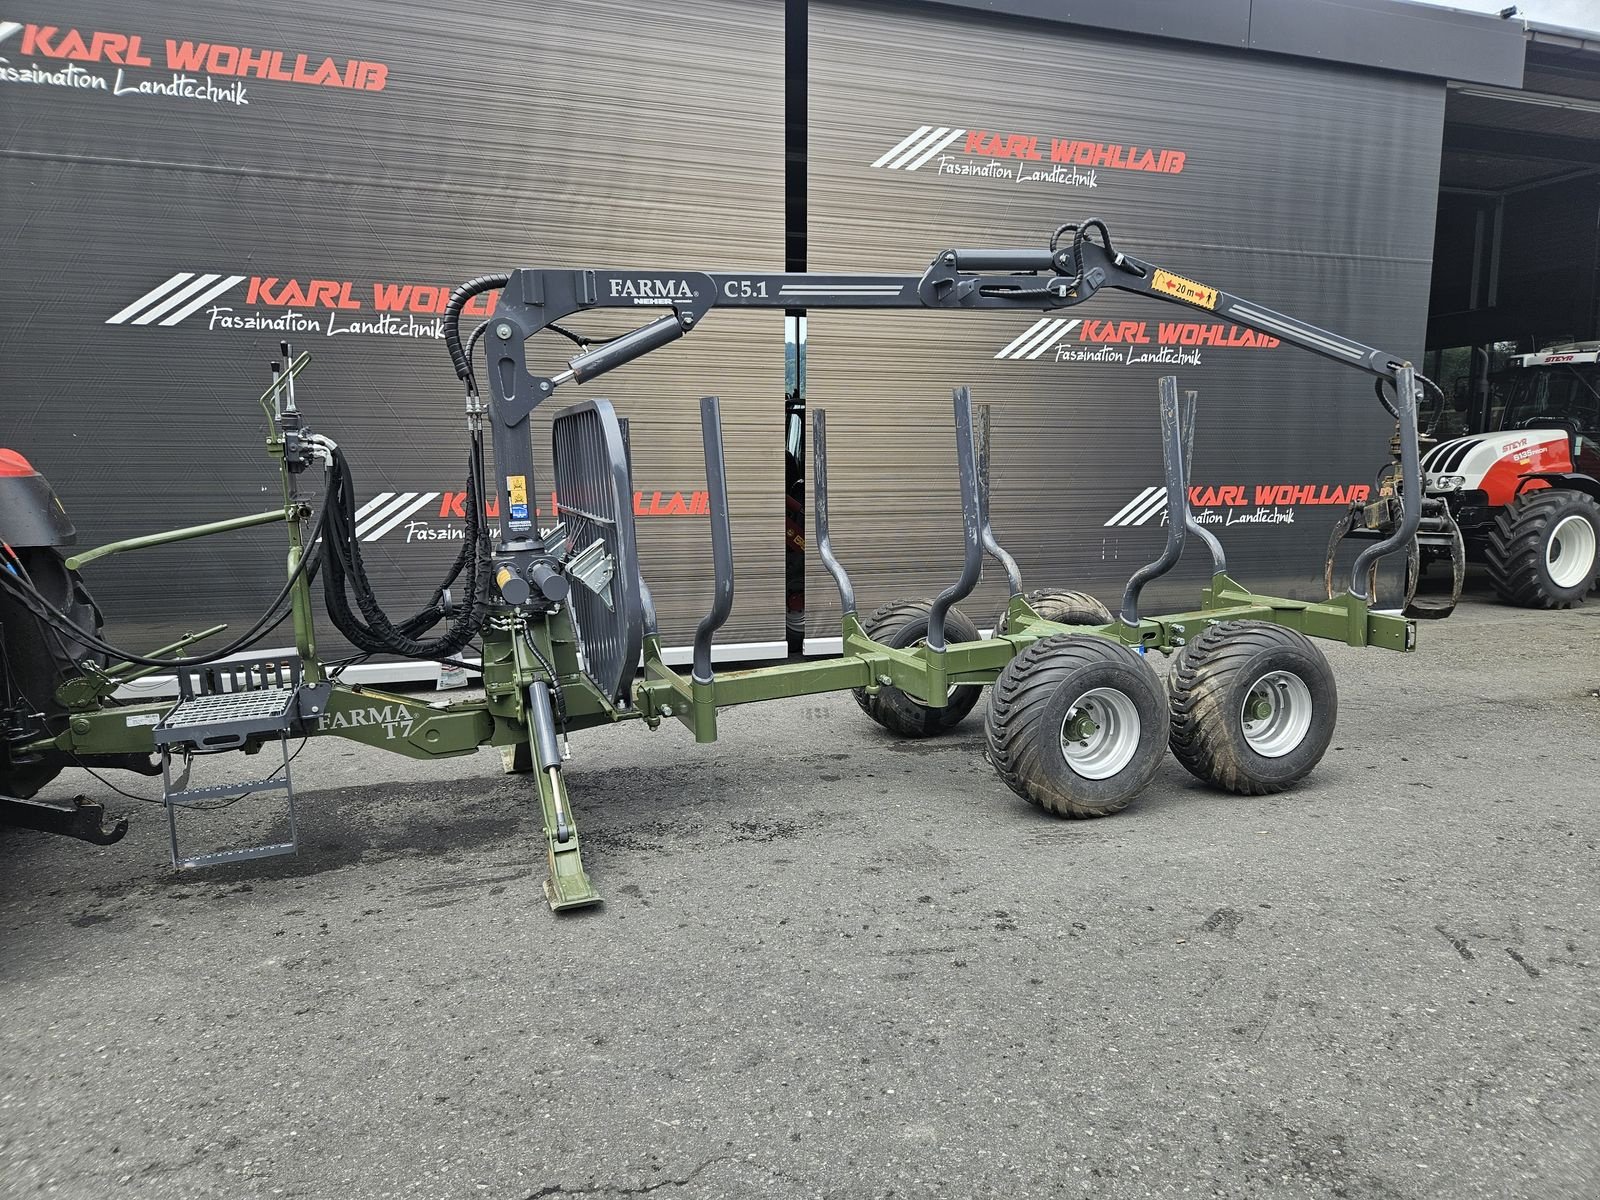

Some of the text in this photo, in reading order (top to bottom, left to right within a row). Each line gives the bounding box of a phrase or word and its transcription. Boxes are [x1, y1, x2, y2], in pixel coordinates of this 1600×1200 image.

[21, 25, 151, 67] KARL
[0, 57, 249, 105] aszination Landtechnik
[965, 131, 1041, 160] KARL
[937, 155, 1098, 188] Faszination Landtechnik
[247, 277, 360, 309] KARL
[609, 279, 694, 297] FARMA
[1176, 282, 1195, 297] 20 m
[207, 306, 445, 340] Faszination Landtechnik
[1080, 320, 1149, 343] KARL
[1055, 343, 1202, 366] Faszination Landtechnik
[1544, 355, 1574, 363] STEYR
[1502, 438, 1527, 453] STEYR
[1189, 486, 1248, 506] KARL
[1226, 508, 1294, 527] Landtechnik
[318, 704, 413, 731] FARMA
[382, 719, 413, 739] T7
